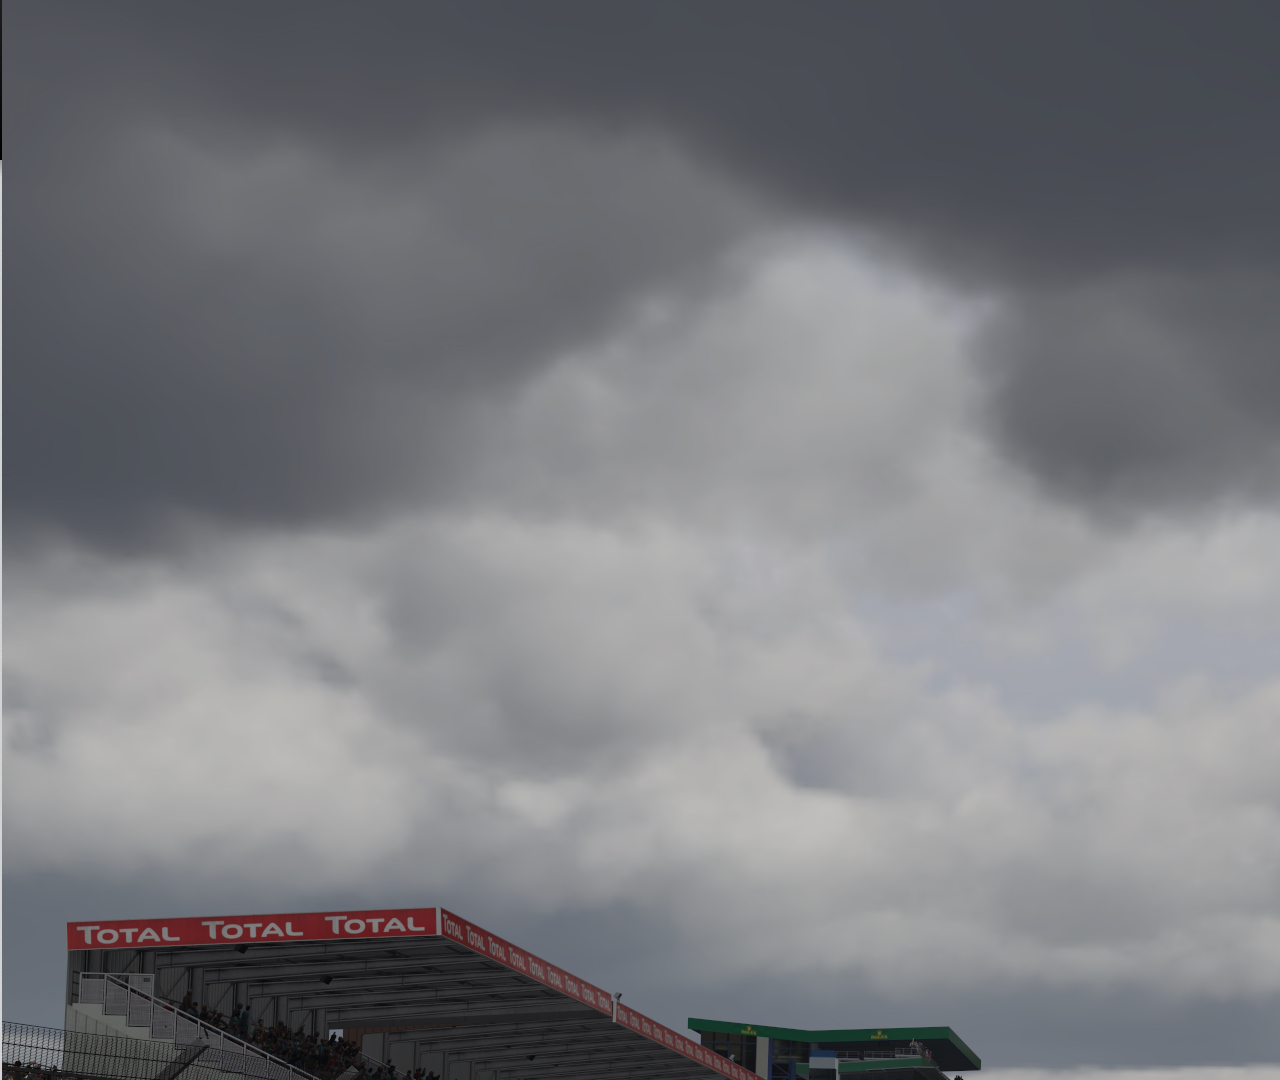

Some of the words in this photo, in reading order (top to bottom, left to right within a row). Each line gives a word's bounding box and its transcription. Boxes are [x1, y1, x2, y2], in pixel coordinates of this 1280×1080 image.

[77, 925, 180, 945] TOTAL
[201, 921, 303, 939] TOTAL
[325, 915, 425, 934] TOTAL
[442, 913, 463, 940] TOTAL
[466, 925, 485, 952] TOTAL
[488, 936, 506, 961] TOTAL
[508, 946, 526, 971] TOTAL
[528, 957, 545, 980] TOTAL
